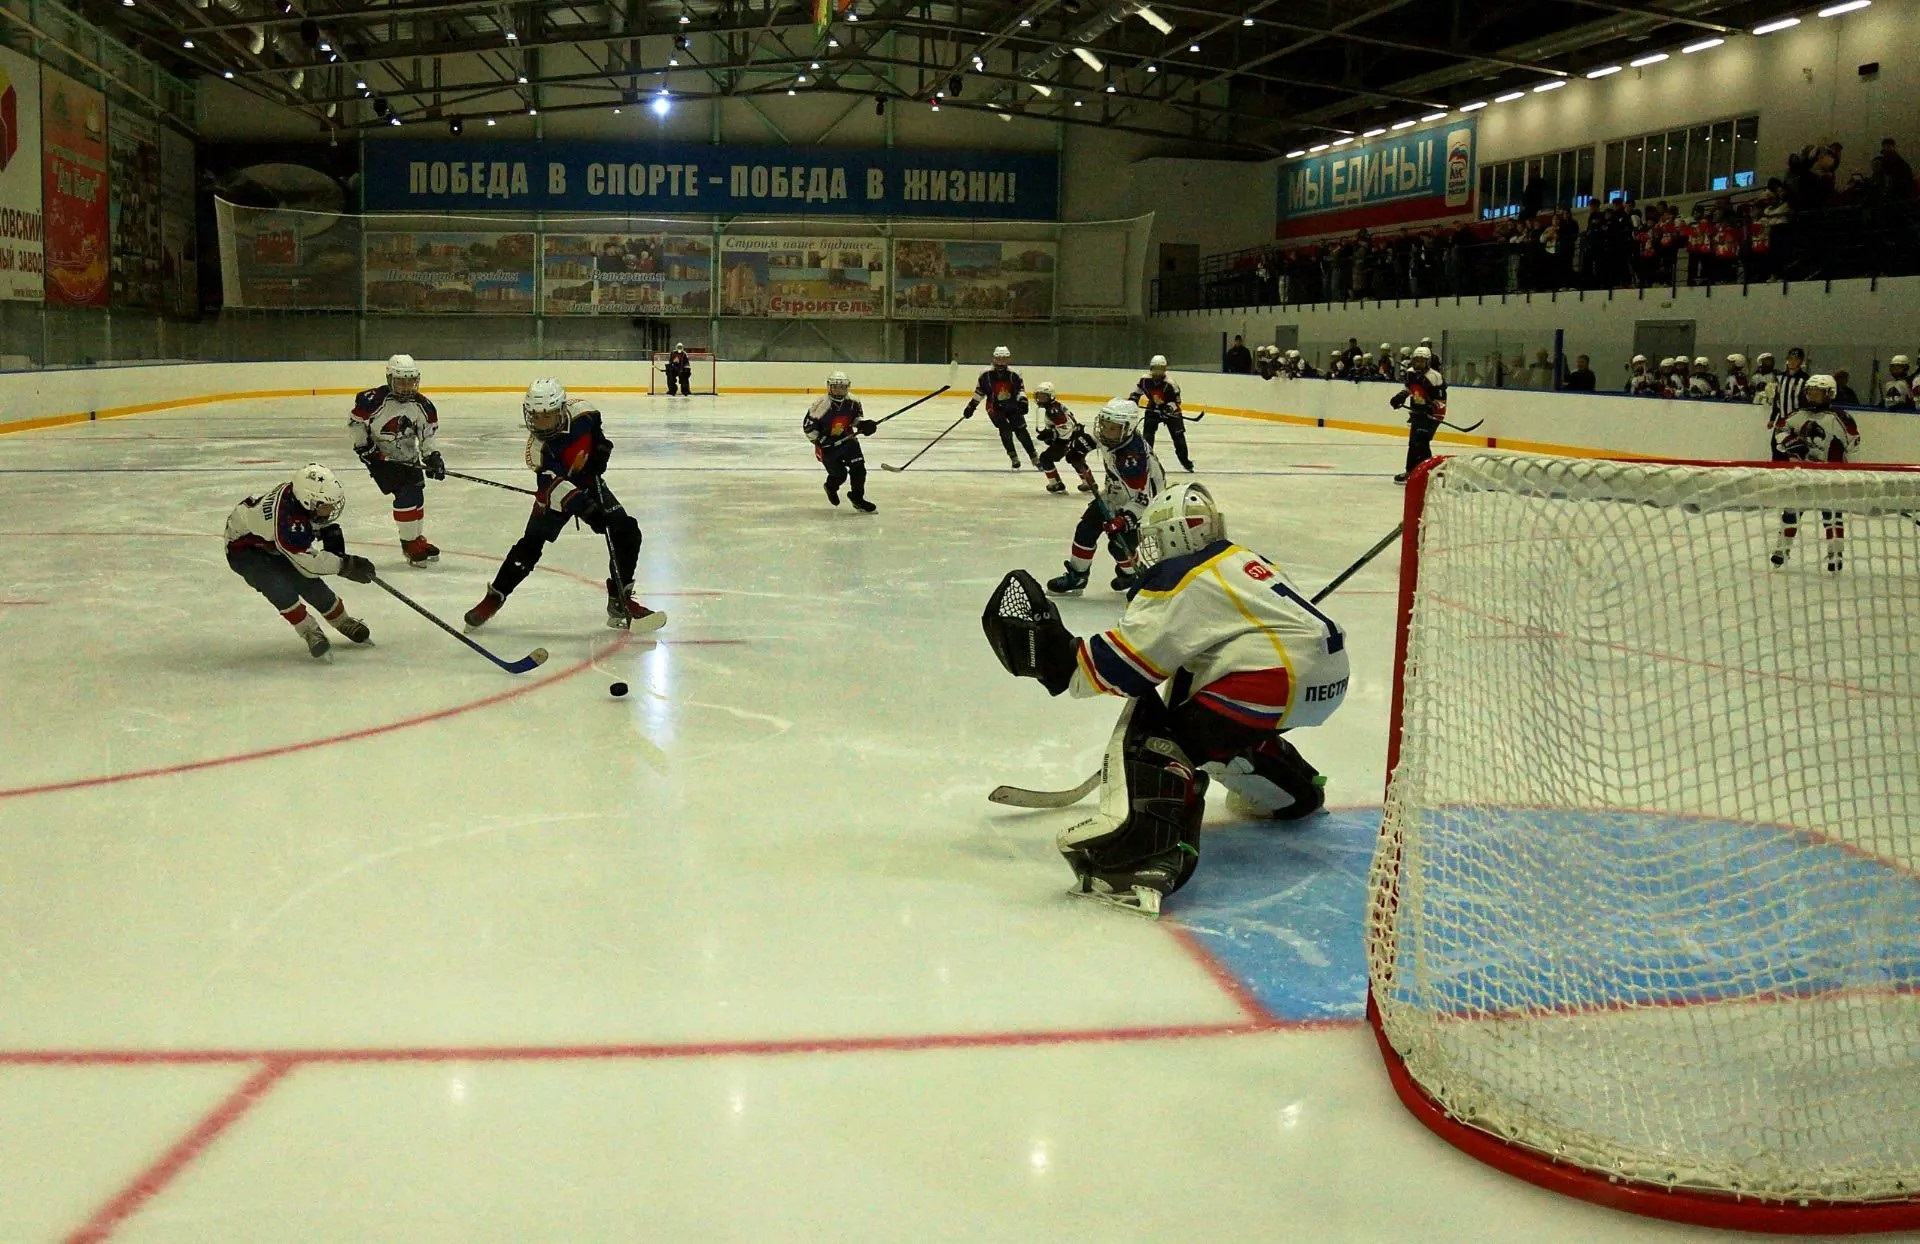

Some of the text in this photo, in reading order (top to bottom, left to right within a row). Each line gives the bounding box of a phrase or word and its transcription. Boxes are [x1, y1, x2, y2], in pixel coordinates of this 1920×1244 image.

[409, 161, 529, 199] ПОБЕДА
[548, 162, 567, 194] В
[587, 162, 699, 197] СПОРТЕ
[730, 165, 848, 203] ПОБЕДА
[866, 167, 884, 200] В
[903, 168, 1017, 204] ЖИЗНИ!
[1288, 139, 1433, 210] МЫ ЕДИНЫ!
[726, 236, 779, 250] Строим
[770, 295, 874, 314] Строитель
[1304, 677, 1349, 702] ПЕСТР
